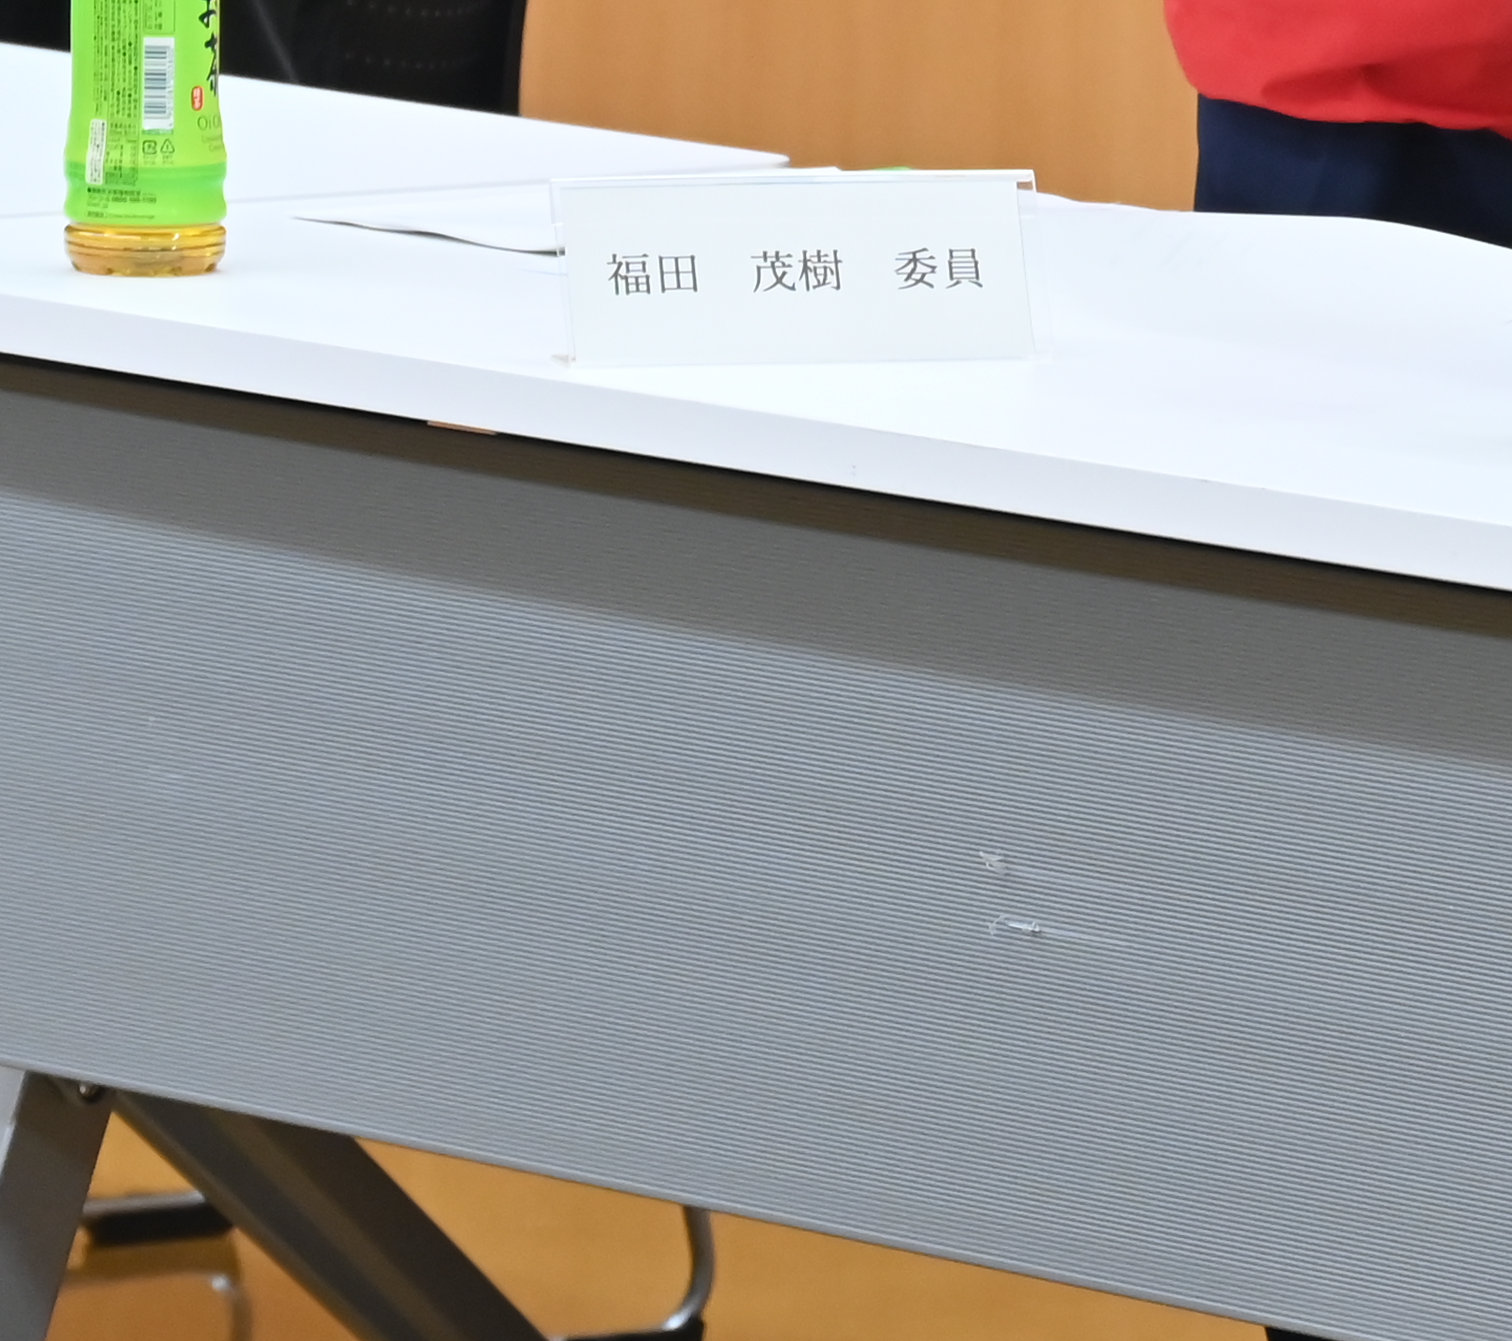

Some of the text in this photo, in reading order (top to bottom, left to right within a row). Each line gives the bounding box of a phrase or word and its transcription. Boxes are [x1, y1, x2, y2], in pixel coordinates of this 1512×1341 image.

[606, 246, 984, 296] 福田 茂樹 委員
